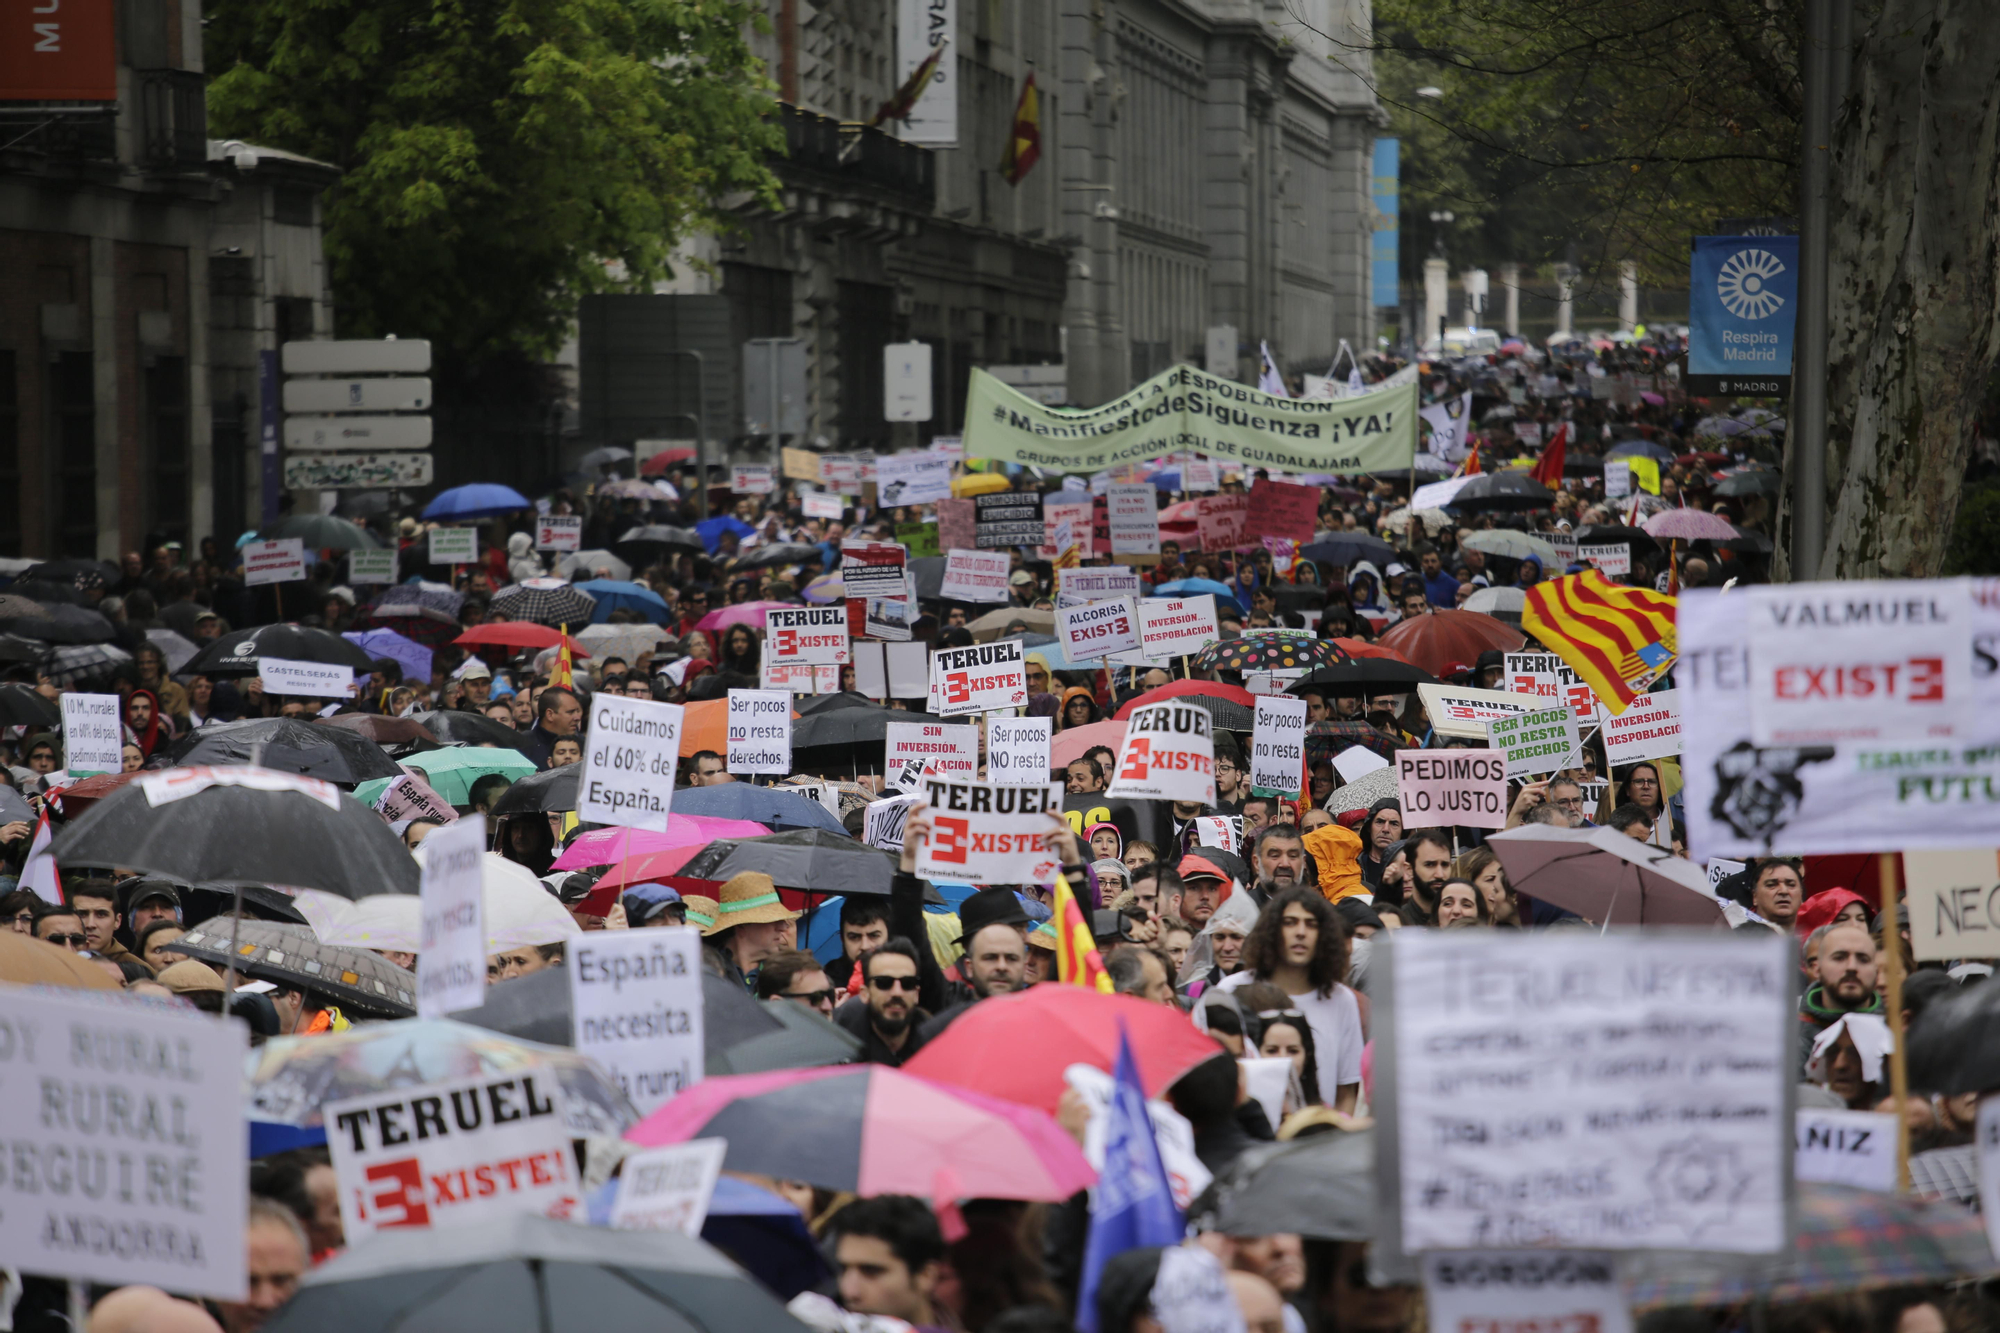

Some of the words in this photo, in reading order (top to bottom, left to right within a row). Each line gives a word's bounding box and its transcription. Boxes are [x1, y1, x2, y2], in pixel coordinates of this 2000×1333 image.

[1722, 330, 1779, 347] Respira
[1723, 347, 1777, 361] Madrid
[1733, 382, 1780, 392] MADRID
[1333, 412, 1393, 444] ¡YA!
[1016, 449, 1081, 467] GRUPOS
[1087, 455, 1106, 466] DE
[1216, 441, 1237, 456] DE
[1242, 446, 1363, 470] GUADALAJARA
[1581, 545, 1629, 556] TERUEL
[1069, 603, 1127, 626] ALCORISA
[1167, 601, 1184, 612] SIN
[1770, 597, 1948, 627] VALMUEL
[769, 609, 845, 627] TERUEL
[1143, 623, 1214, 643] DESPOBLACIÓN
[937, 643, 1021, 671] TERUEL
[267, 666, 341, 680] CASTELSERÁS
[286, 680, 317, 689] RESISTE
[1269, 680, 1284, 689] SIN
[90, 702, 115, 716] rurales
[731, 696, 750, 713] Ser
[753, 700, 786, 717] pocos
[1441, 697, 1526, 712] TERUEL
[1632, 696, 1652, 709] SIN
[598, 708, 675, 740] Cuidamos
[1257, 706, 1272, 727] Ser
[1274, 711, 1302, 732] pocos
[1492, 717, 1519, 735] SER
[1522, 708, 1568, 729] POCOS
[69, 728, 78, 739] en
[93, 725, 102, 739] del
[730, 725, 746, 739] no
[751, 724, 785, 739] resta
[922, 725, 942, 737] SIN
[991, 724, 1012, 747] ¡Ser
[1014, 727, 1047, 747] pocos
[1497, 734, 1517, 750] NO
[1519, 725, 1567, 743] RESTA
[70, 747, 98, 768] pedimos
[594, 745, 610, 768] el
[613, 747, 646, 773] 60%
[650, 752, 671, 776] de
[729, 748, 785, 765] derechos.
[990, 750, 1010, 769] NO
[1013, 753, 1046, 769] resta
[1255, 740, 1269, 757] no
[1271, 743, 1300, 760] resta
[1255, 769, 1300, 790] derechos.
[1401, 758, 1504, 782] PEDIMOS
[398, 780, 430, 812] España
[588, 780, 666, 813] España.
[926, 780, 1058, 814] TERUEL
[1404, 791, 1431, 812] LO
[1438, 790, 1504, 815] JUSTO.
[576, 945, 689, 991] España
[582, 1003, 693, 1042] necesita
[635, 1058, 690, 1098] rural
[39, 1075, 200, 1149] RURAL
[337, 1076, 554, 1153] TERUEL
